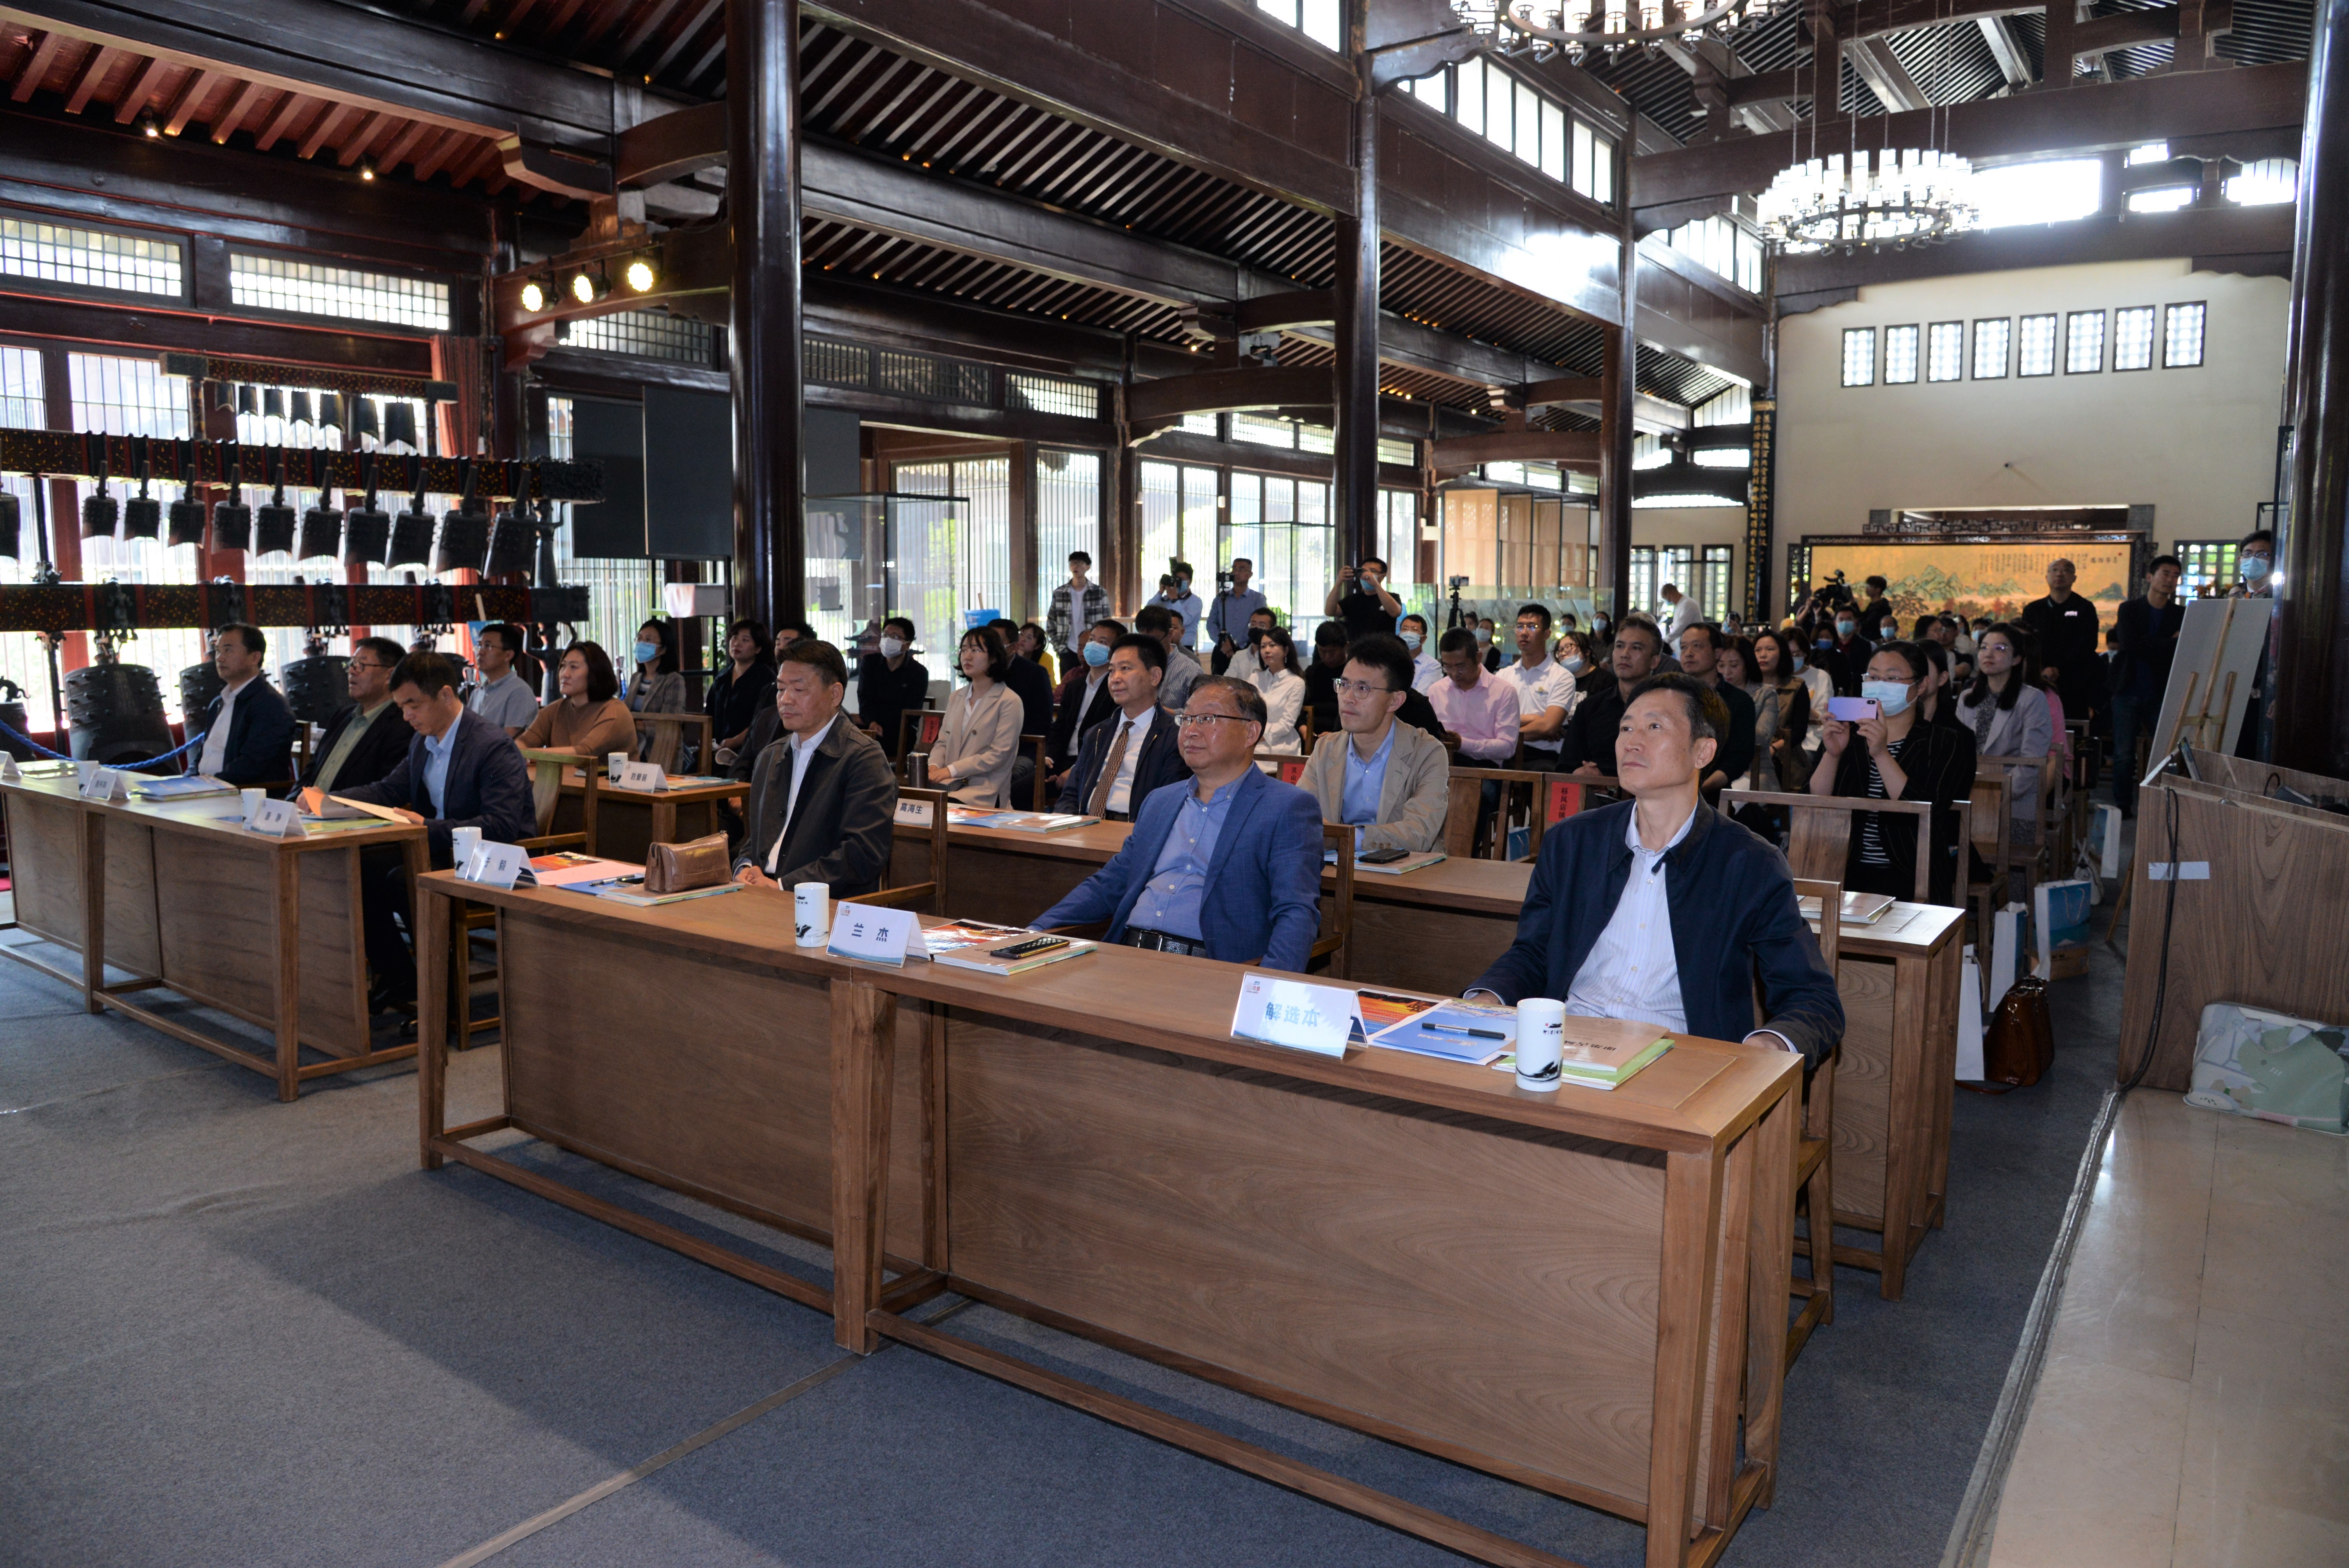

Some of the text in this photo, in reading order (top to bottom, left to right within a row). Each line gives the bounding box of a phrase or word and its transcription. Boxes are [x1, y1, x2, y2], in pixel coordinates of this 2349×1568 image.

[900, 803, 923, 814] 高海生
[851, 923, 889, 942] 兰杰
[1264, 1001, 1320, 1027] 解选本
